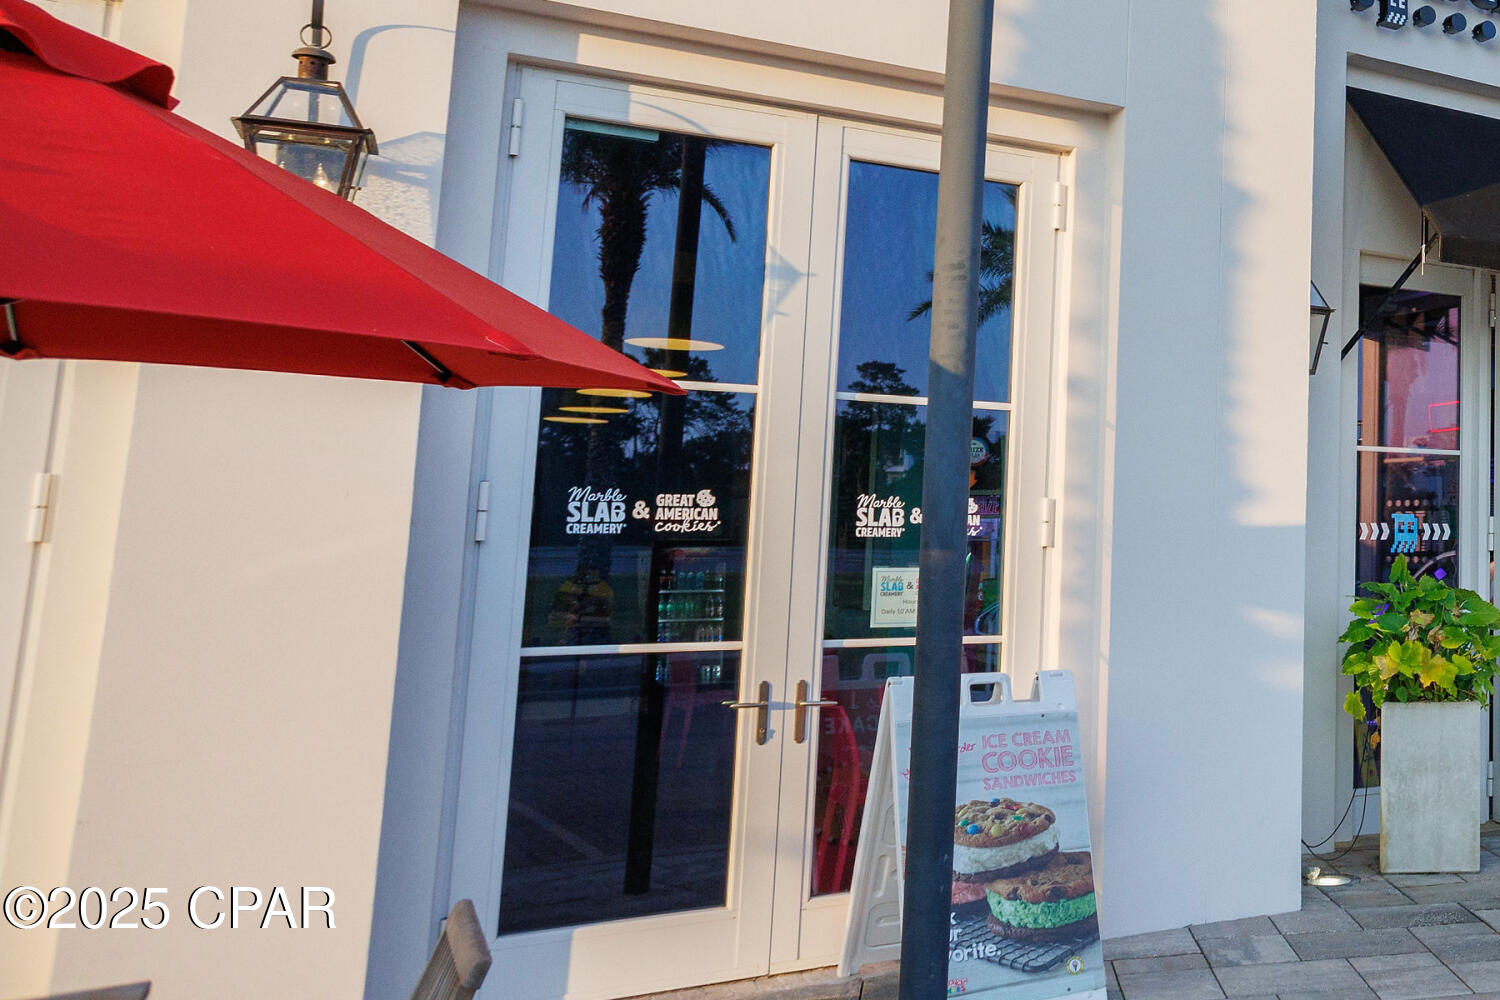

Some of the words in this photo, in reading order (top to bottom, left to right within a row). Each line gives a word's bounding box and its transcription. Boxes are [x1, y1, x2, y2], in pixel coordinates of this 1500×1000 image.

[567, 485, 628, 503] Marble
[655, 493, 696, 507] GREAT
[856, 493, 906, 509] Marble
[566, 501, 627, 523] SLAB
[631, 500, 650, 520] &
[654, 507, 719, 521] AMERICAN
[855, 507, 905, 527] SLAB
[565, 523, 624, 535] CREAMERY
[654, 518, 719, 533] cookies
[855, 527, 903, 538] CREAMERY
[880, 582, 904, 591] SLAB
[906, 581, 914, 590] &
[981, 733, 1008, 750] ICE
[1011, 729, 1071, 747] CREAM
[981, 745, 1075, 774] COOKIE
[983, 770, 1077, 791] SANDWICHES
